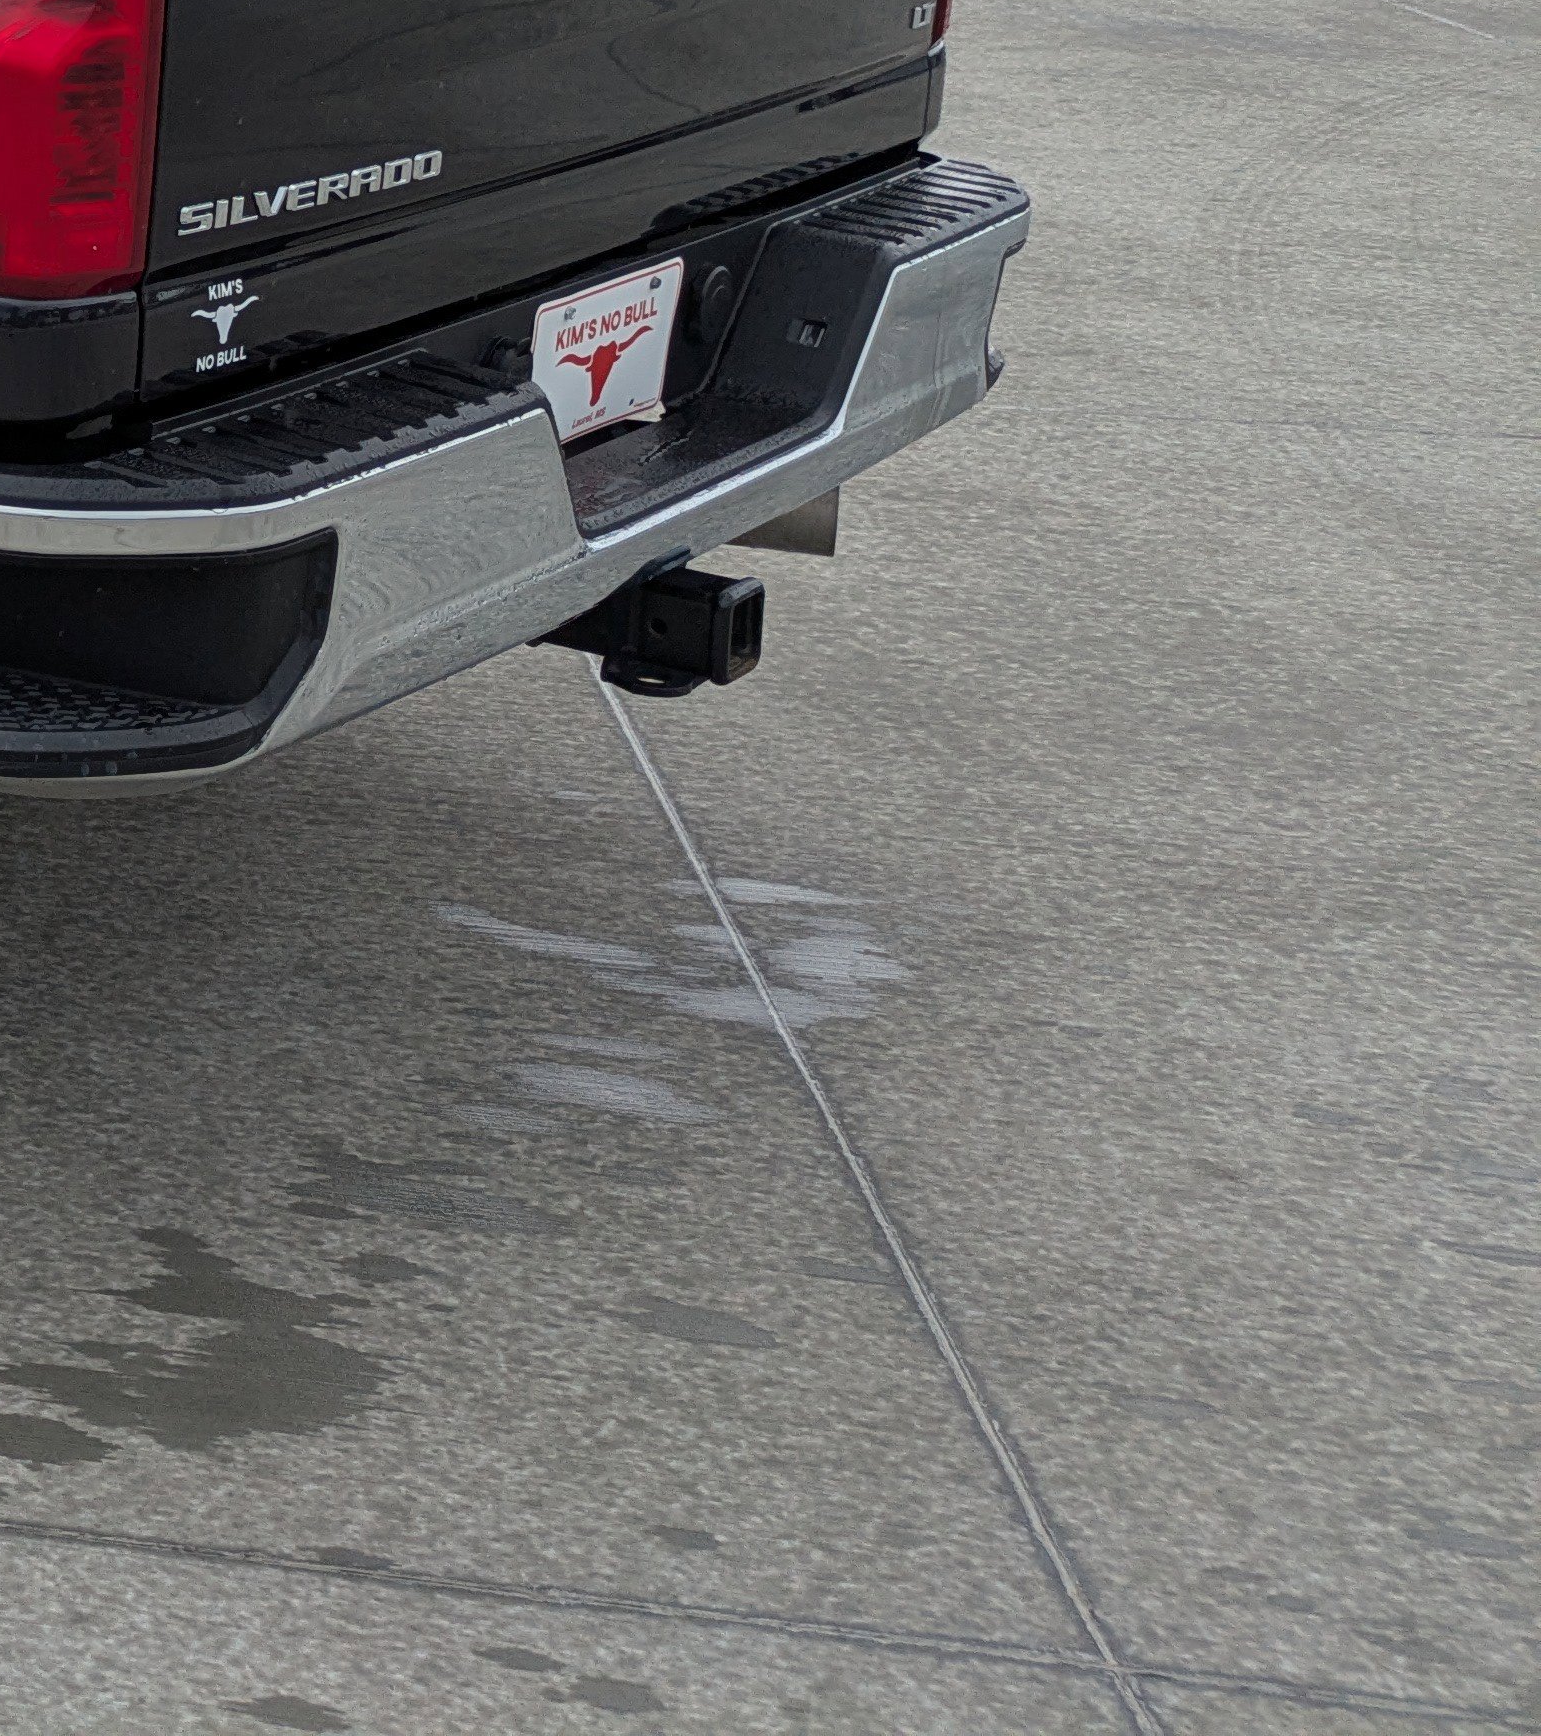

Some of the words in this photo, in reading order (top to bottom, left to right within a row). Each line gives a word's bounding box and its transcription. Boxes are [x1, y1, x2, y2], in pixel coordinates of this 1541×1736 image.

[911, 2, 936, 30] LT
[177, 149, 443, 237] SILVERADO
[208, 278, 244, 301] KIM'S
[555, 319, 597, 352] KIM'S
[599, 310, 621, 336] NO
[623, 296, 658, 328] BULL
[195, 353, 215, 373] NO
[216, 345, 247, 368] BULL
